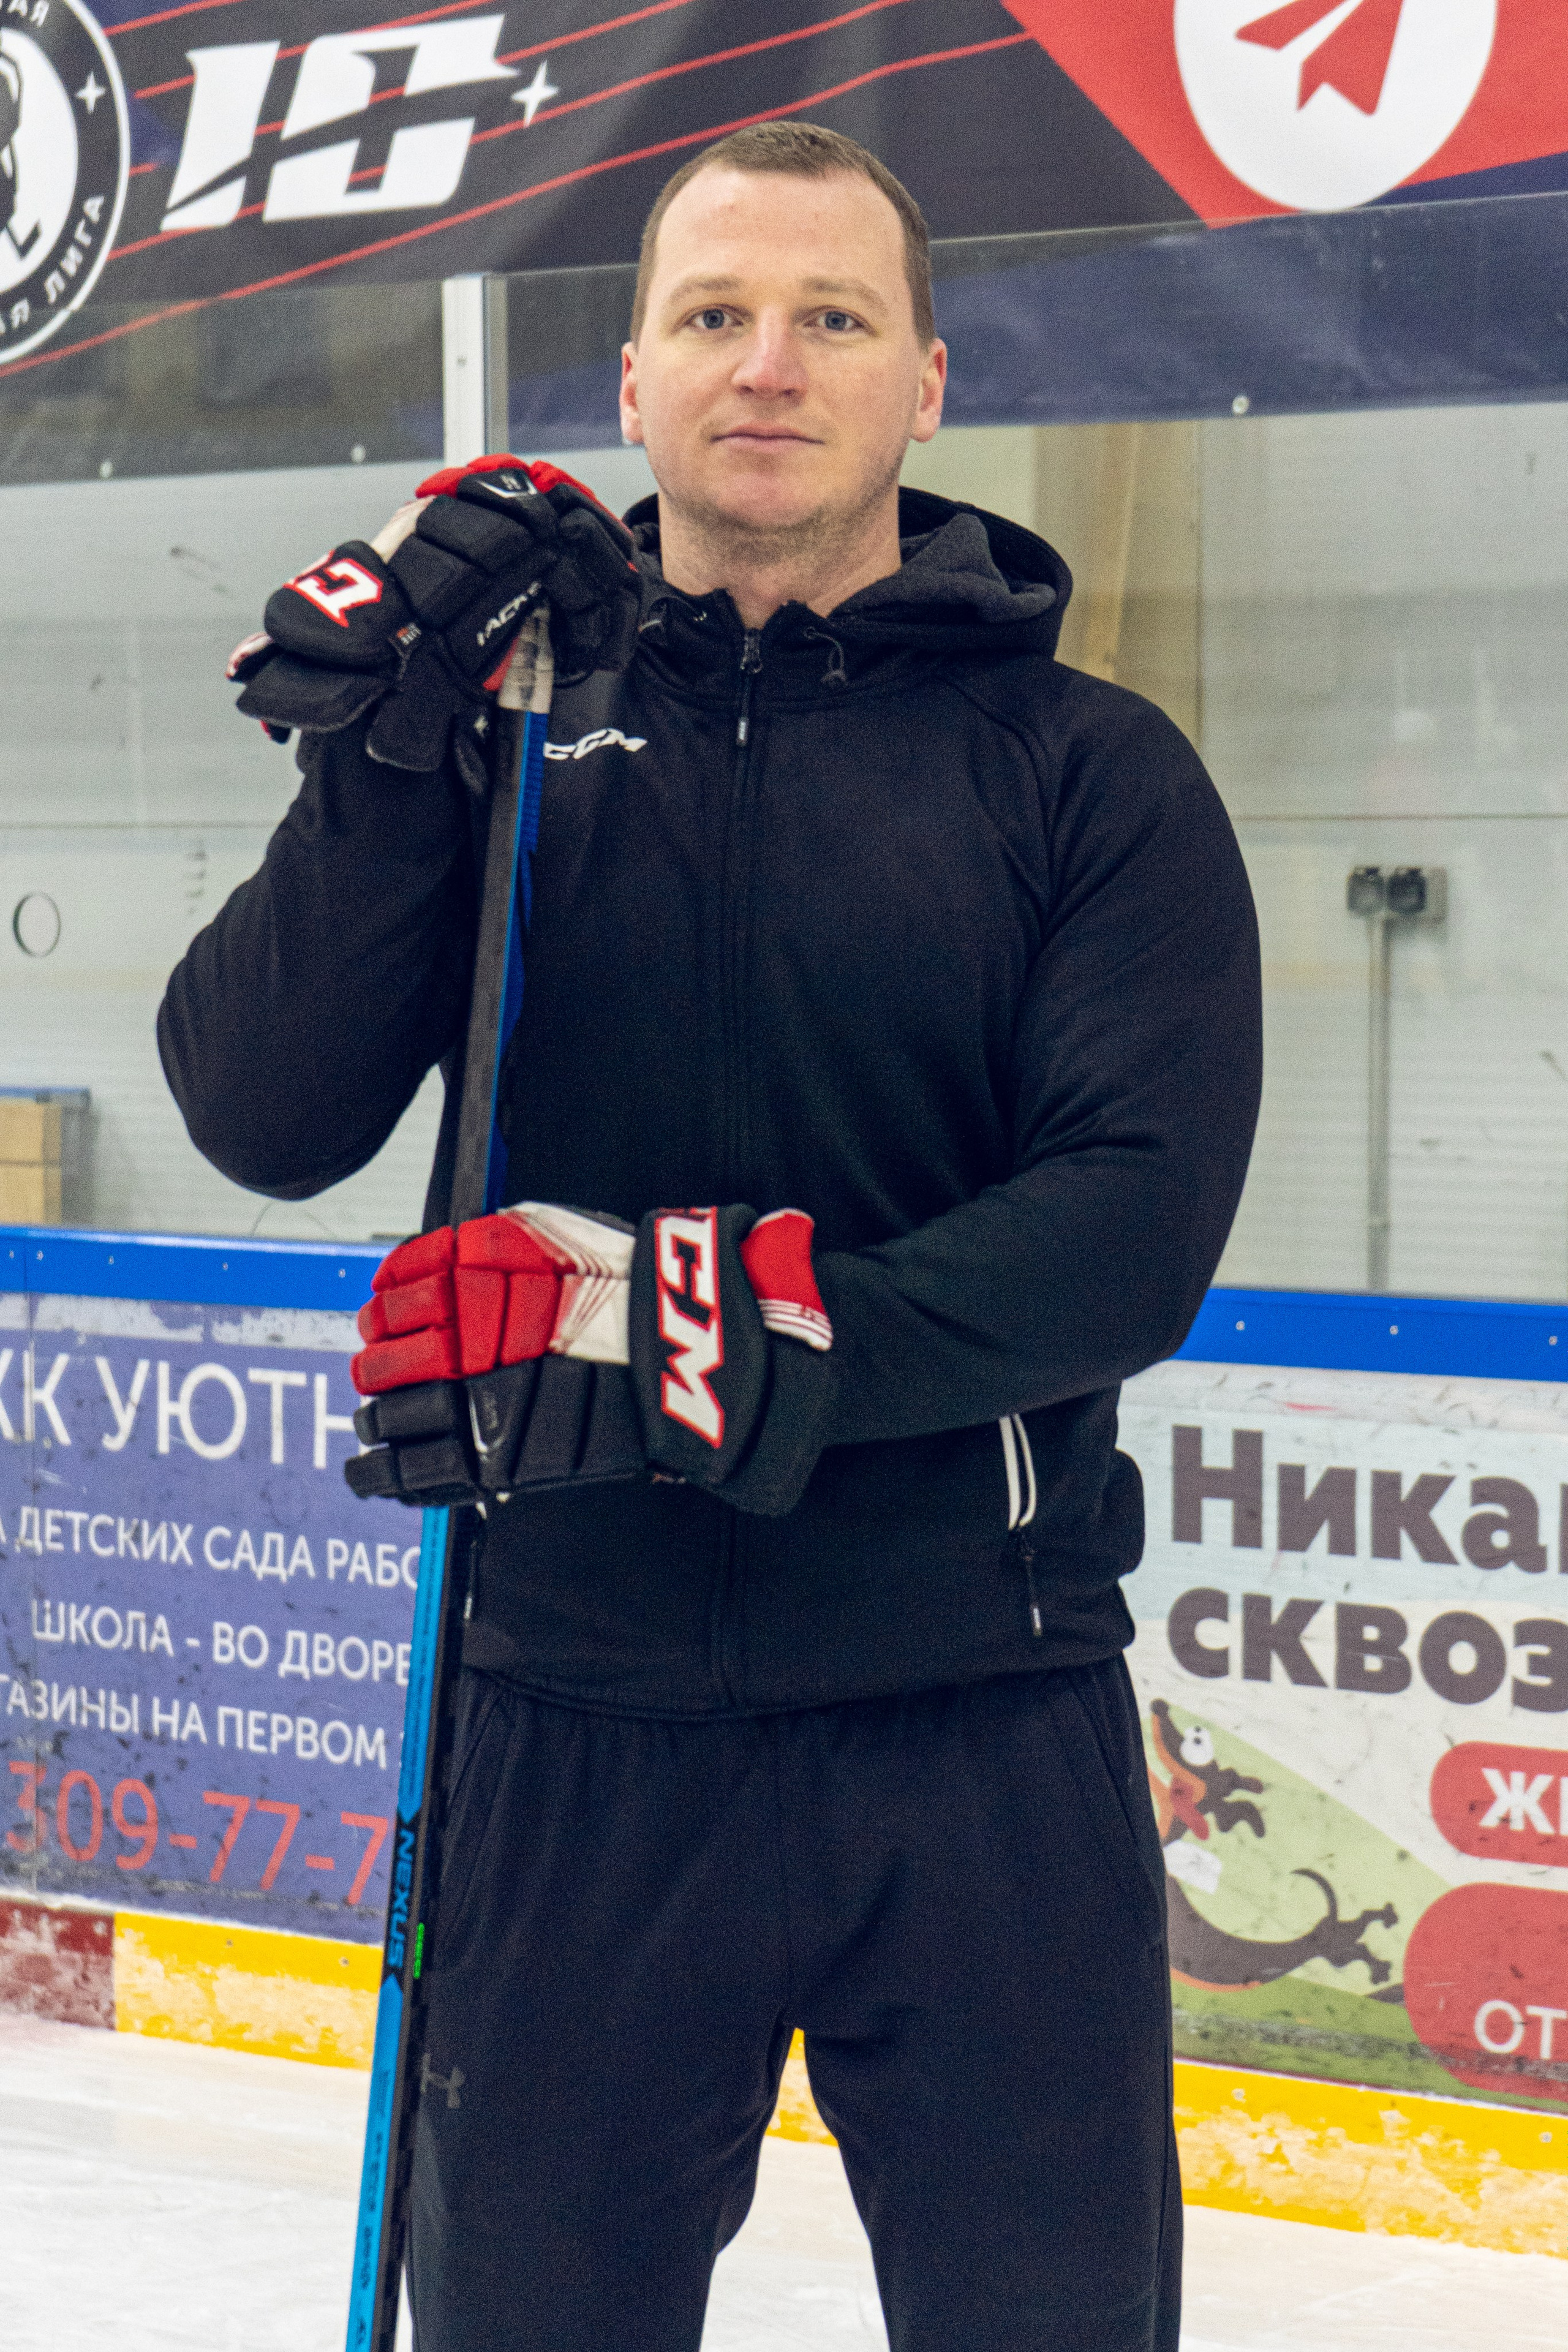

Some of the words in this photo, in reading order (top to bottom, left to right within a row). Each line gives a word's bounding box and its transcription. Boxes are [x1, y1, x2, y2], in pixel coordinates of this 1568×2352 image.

[0, 0, 49, 26] АЯ
[43, 195, 105, 304] ЛИГА
[655, 1206, 725, 1450] CM
[1171, 1423, 1568, 1574] Ника
[15, 1505, 194, 1566] ДЕТСКИХ
[203, 1525, 317, 1585] САДА
[32, 1599, 175, 1657] ШКОЛА
[212, 1621, 269, 1668] ВО
[152, 1696, 208, 1744] НА
[216, 1705, 388, 1771] ПЕРВОМ
[1479, 1767, 1568, 1836] Ж
[386, 1828, 415, 1968] NEXUS
